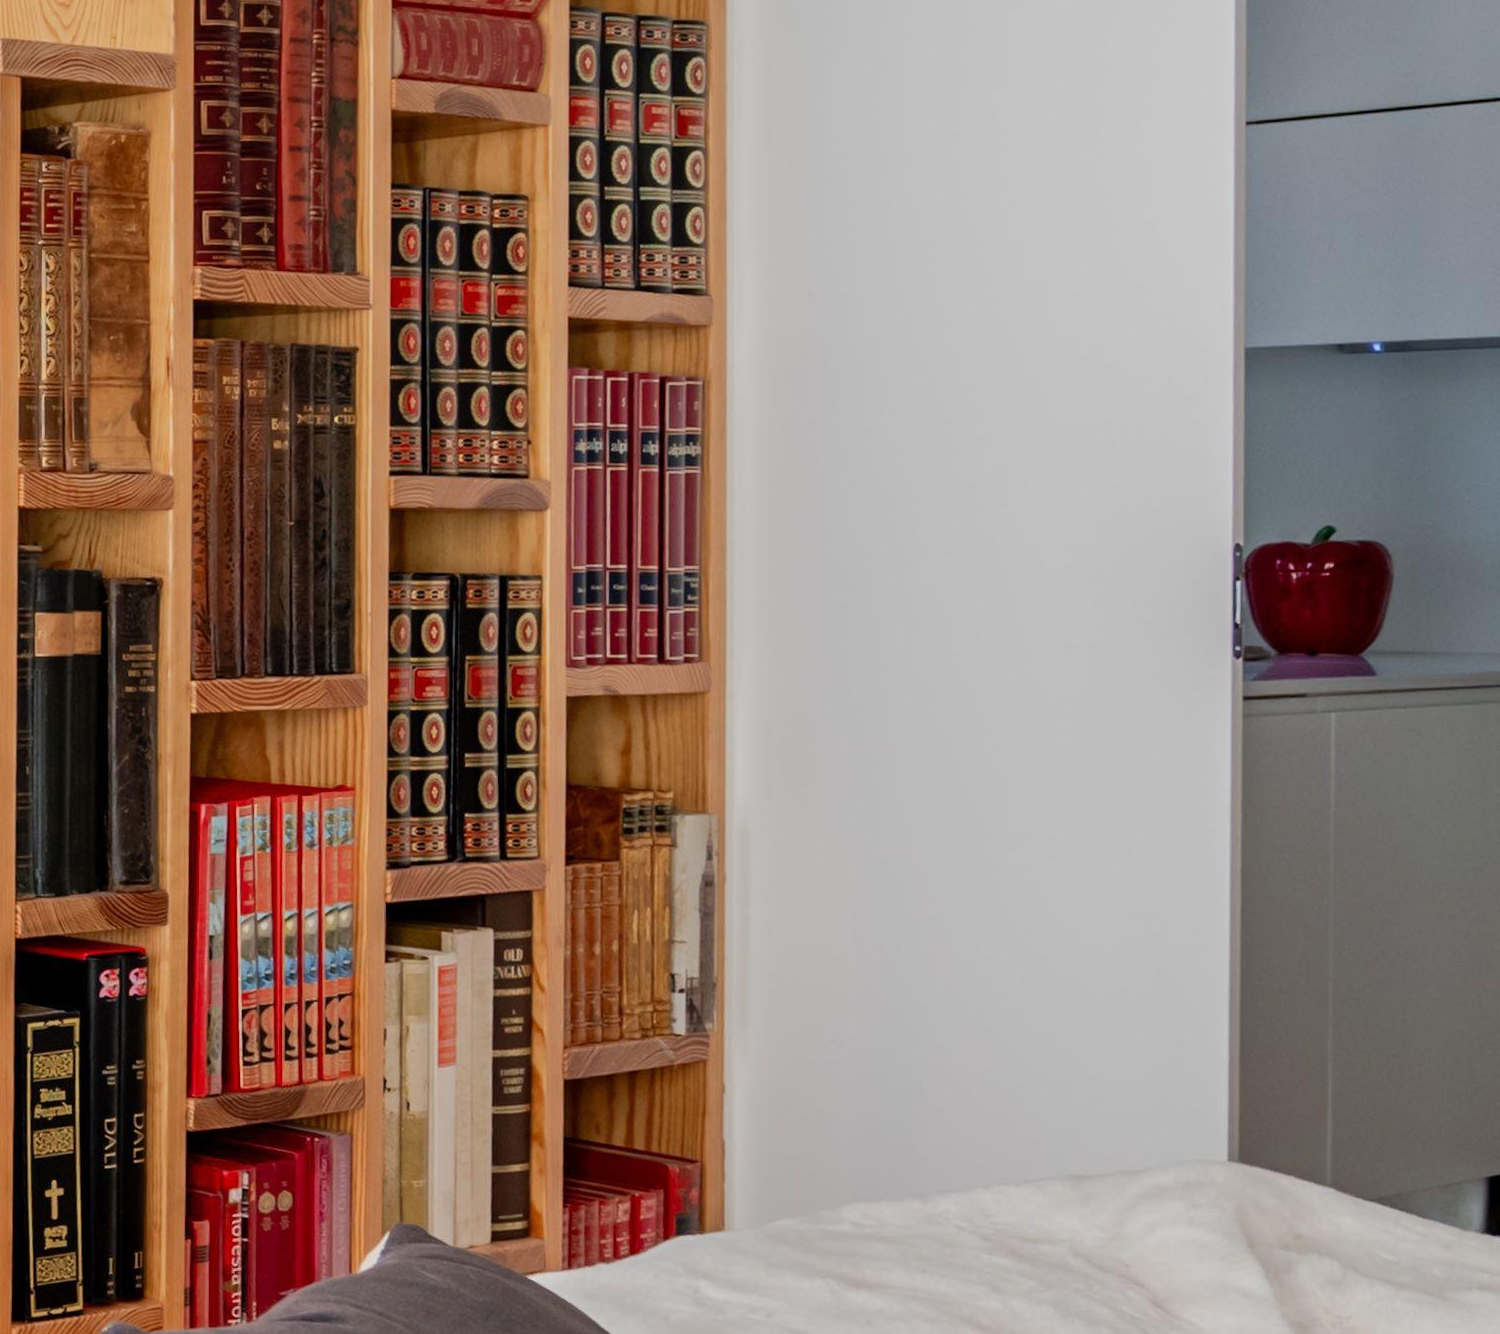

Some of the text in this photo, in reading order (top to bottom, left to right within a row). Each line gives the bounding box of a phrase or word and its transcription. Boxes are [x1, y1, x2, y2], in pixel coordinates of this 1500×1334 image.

[504, 948, 523, 962] OLD
[104, 1117, 117, 1169] DALI
[133, 1112, 145, 1164] DALI
